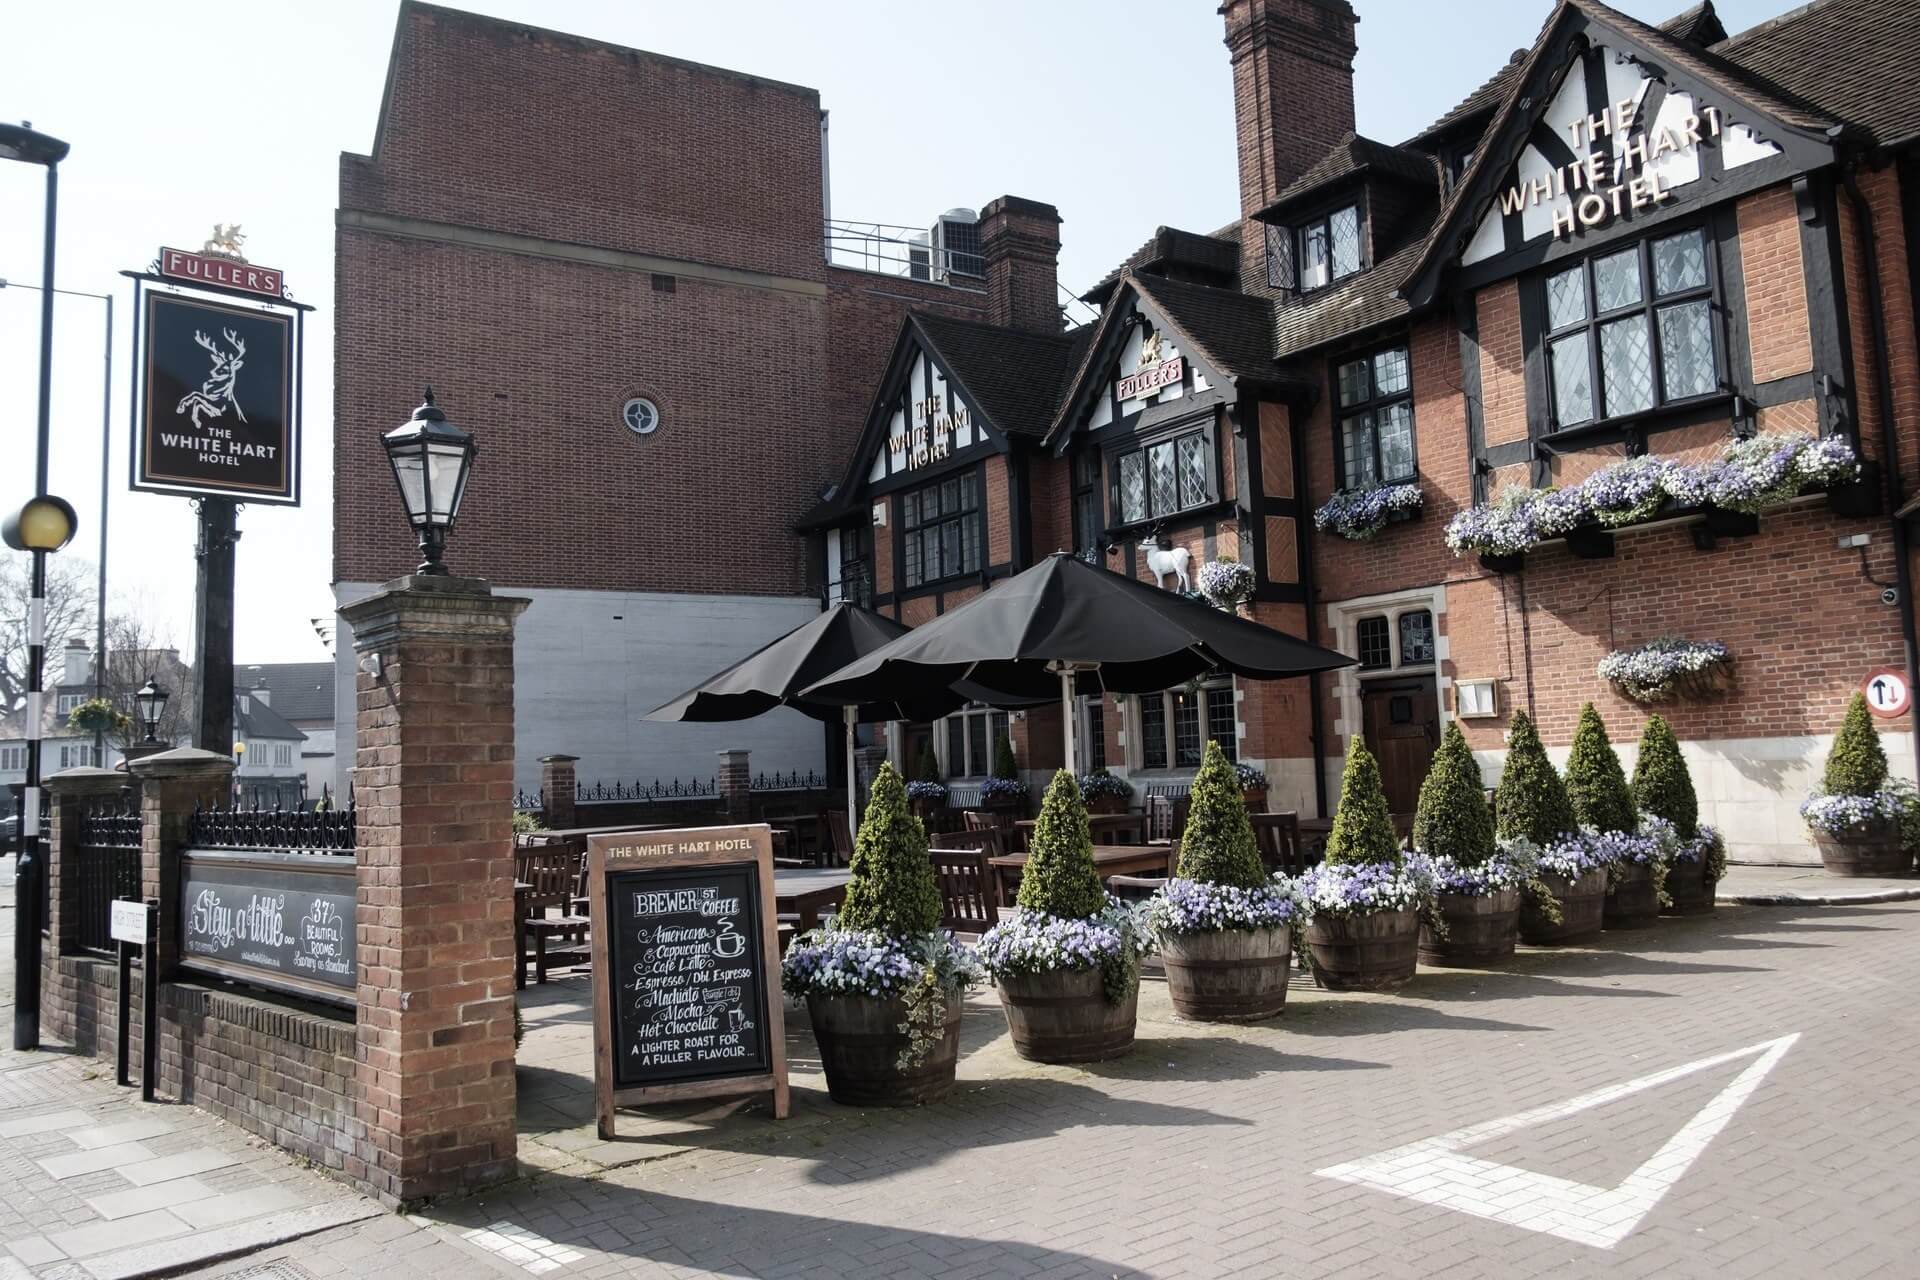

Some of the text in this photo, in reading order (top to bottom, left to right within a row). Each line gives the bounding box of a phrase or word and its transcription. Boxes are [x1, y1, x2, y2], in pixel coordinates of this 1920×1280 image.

[1568, 98, 1635, 149] THE
[1501, 106, 1721, 216] WHITE HART
[1552, 172, 1669, 239] HOTEL
[170, 254, 275, 290] FULLER'S
[1119, 364, 1178, 397] FULLER'S
[916, 395, 941, 419] THE
[208, 427, 232, 439] THE
[889, 408, 970, 455] WHITE HART
[161, 433, 276, 459] WHITE HART
[908, 441, 950, 472] HOTEL
[199, 453, 240, 466] HOTEL
[608, 839, 752, 858] THE WHITE HART HOTEL
[314, 898, 330, 925] 37
[637, 889, 715, 915] BREWER ST
[701, 898, 739, 916] COFFEE
[190, 889, 235, 950] Stay
[236, 909, 248, 940] a
[306, 924, 339, 942] BEAUTIFUL
[650, 925, 714, 944] Americano
[311, 941, 335, 958] ROOMS
[653, 941, 711, 961] Cappuccino
[679, 955, 711, 971] Latte
[635, 975, 685, 991] Espresso
[713, 968, 752, 984] Espresso
[662, 1003, 704, 1020] Mocha
[640, 1015, 719, 1038] Hot Chocolate
[631, 1034, 739, 1055] A LIGHTER ROAST FOR
[642, 1055, 650, 1066] A
[653, 1052, 692, 1065] FULLER
